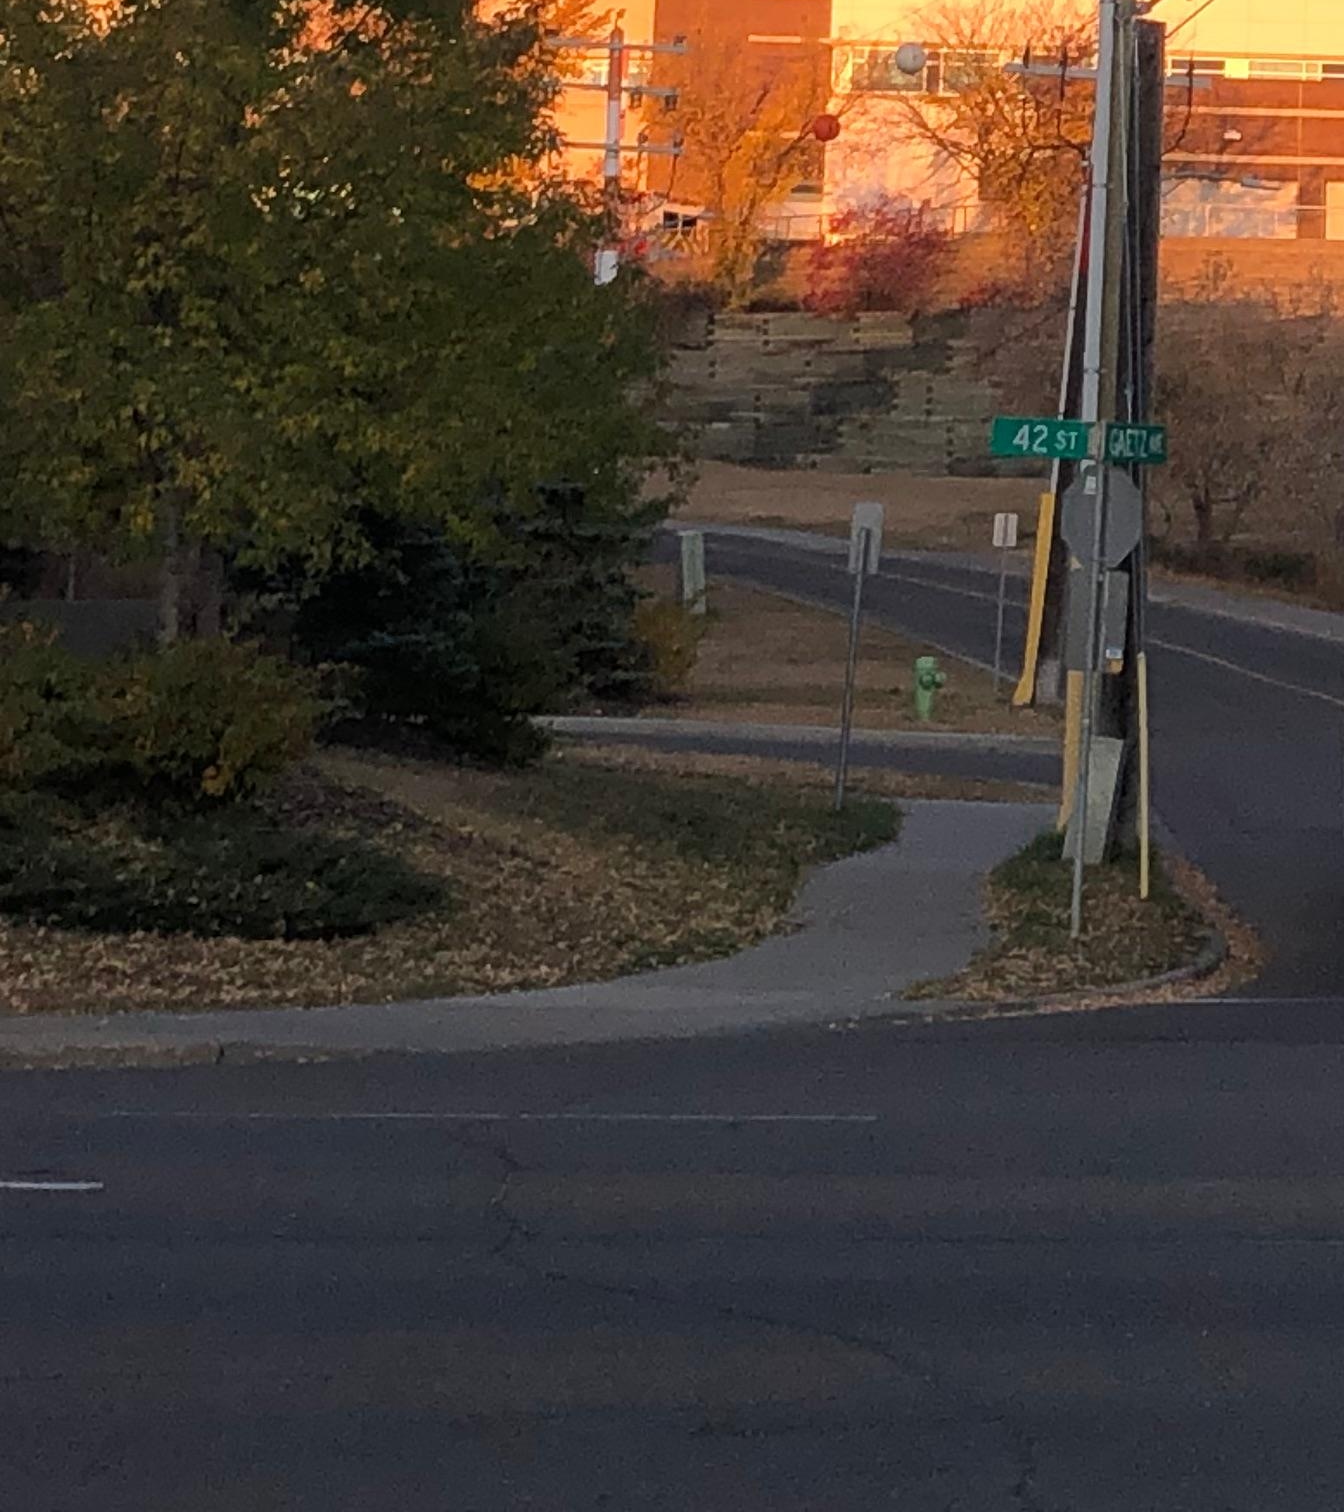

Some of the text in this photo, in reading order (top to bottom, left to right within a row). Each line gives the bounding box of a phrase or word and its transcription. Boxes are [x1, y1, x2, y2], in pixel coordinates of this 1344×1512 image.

[1012, 423, 1078, 454] 42 ST
[1109, 428, 1148, 457] GAETZ
